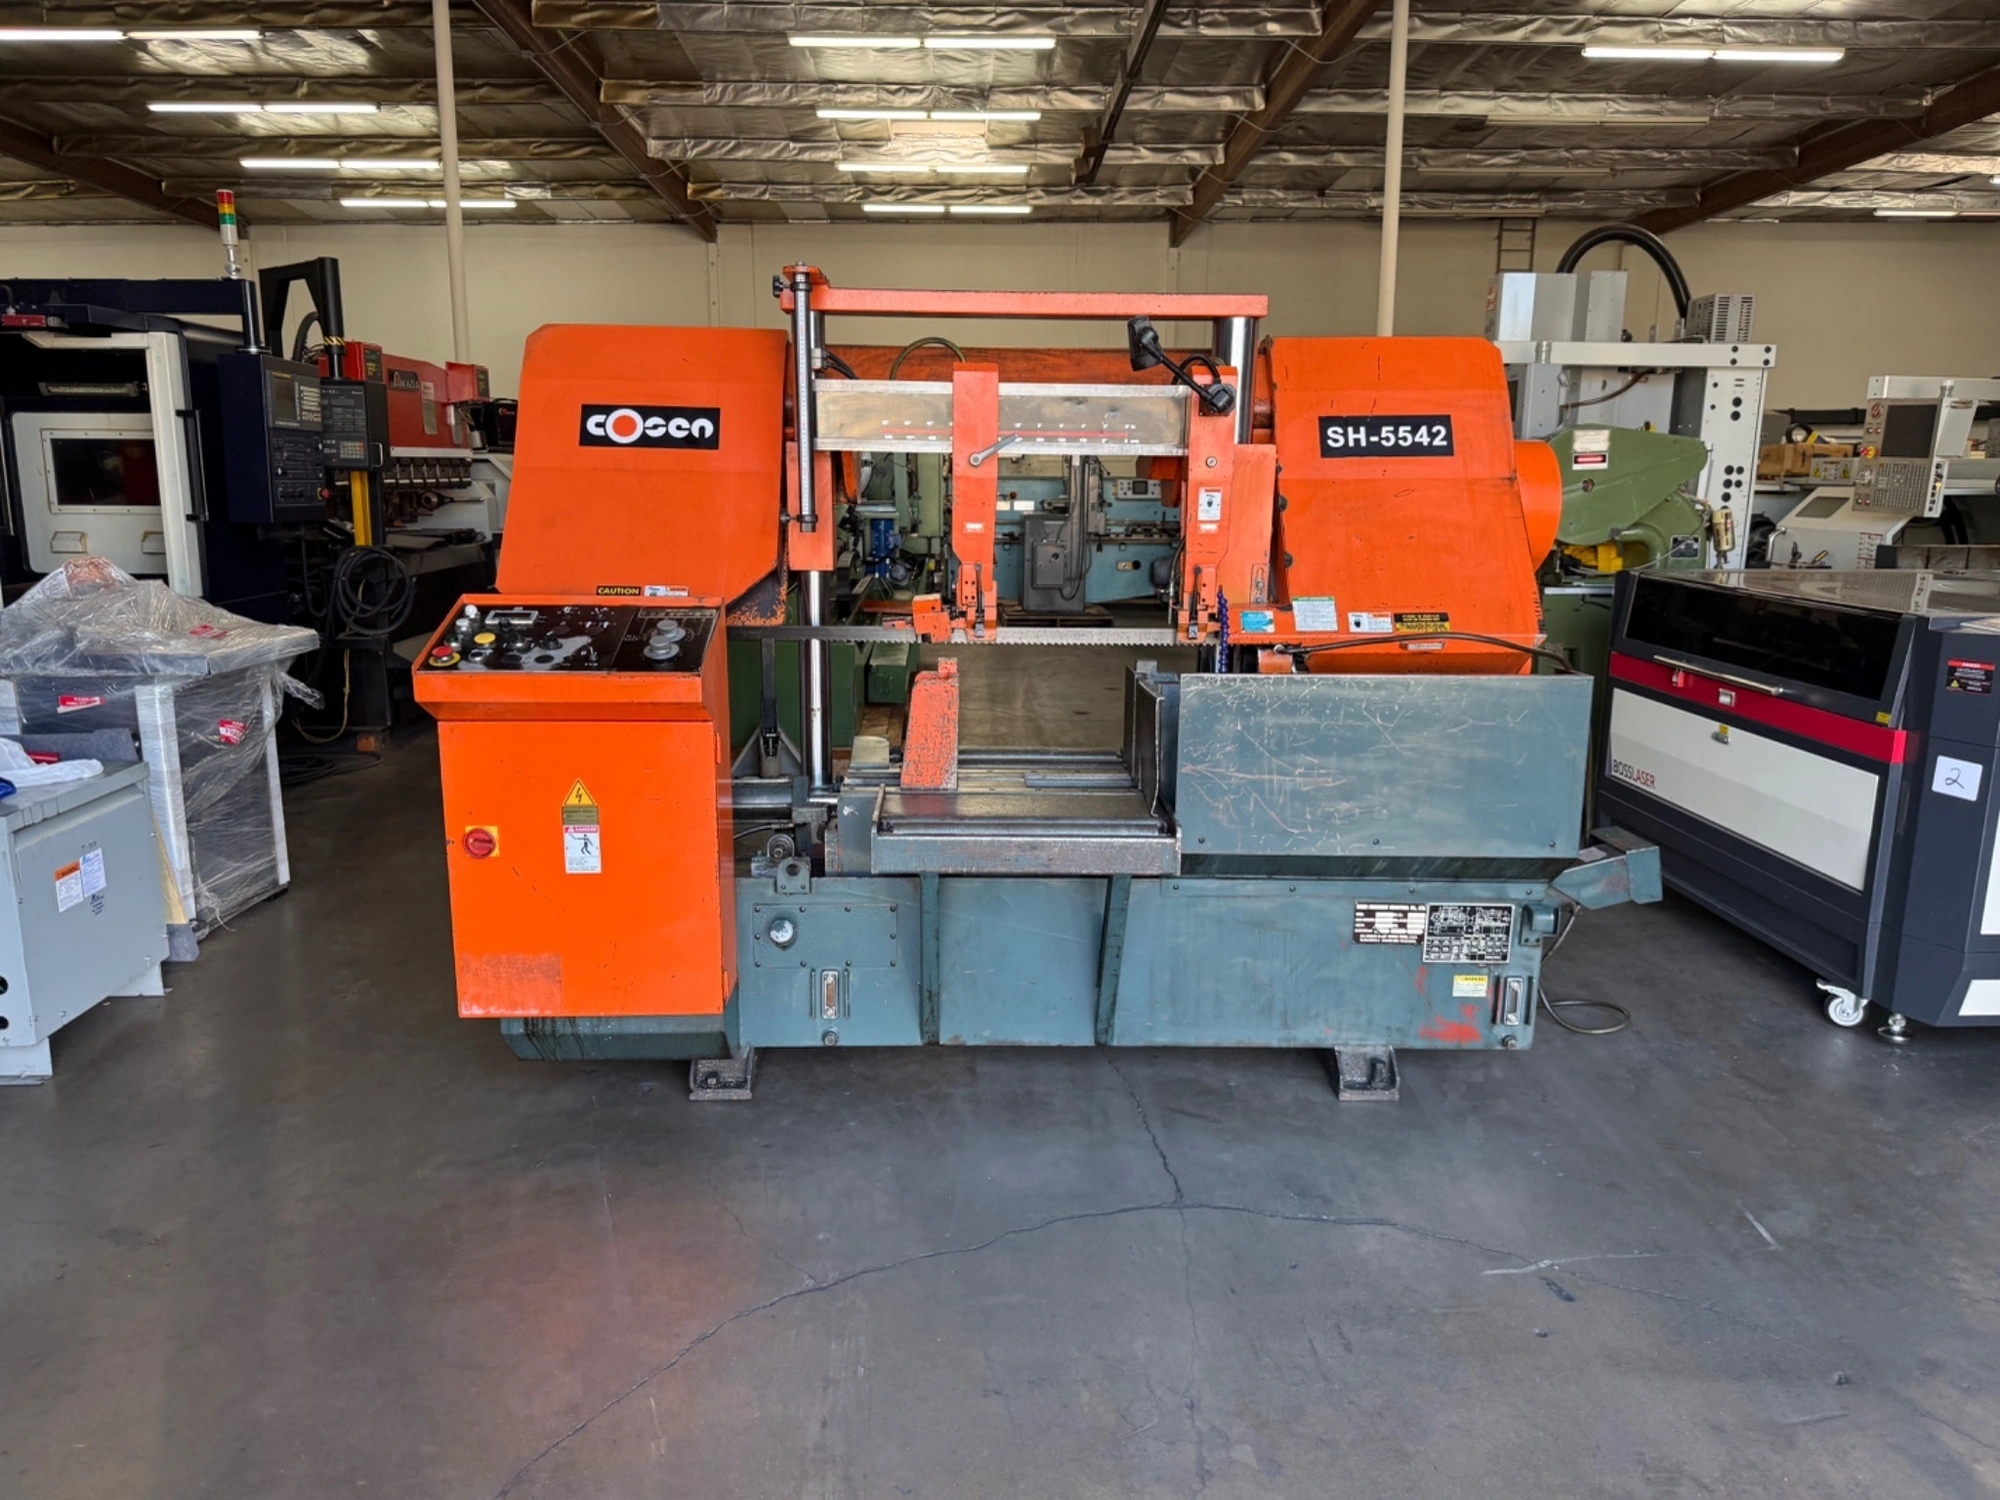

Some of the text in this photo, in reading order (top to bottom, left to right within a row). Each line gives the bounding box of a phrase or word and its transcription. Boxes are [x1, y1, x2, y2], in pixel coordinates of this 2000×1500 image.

[1326, 425, 1448, 447] SH-5542
[597, 587, 640, 595] CAUTION
[1613, 759, 1656, 791] BOSSLASER
[1944, 767, 1965, 790] 2
